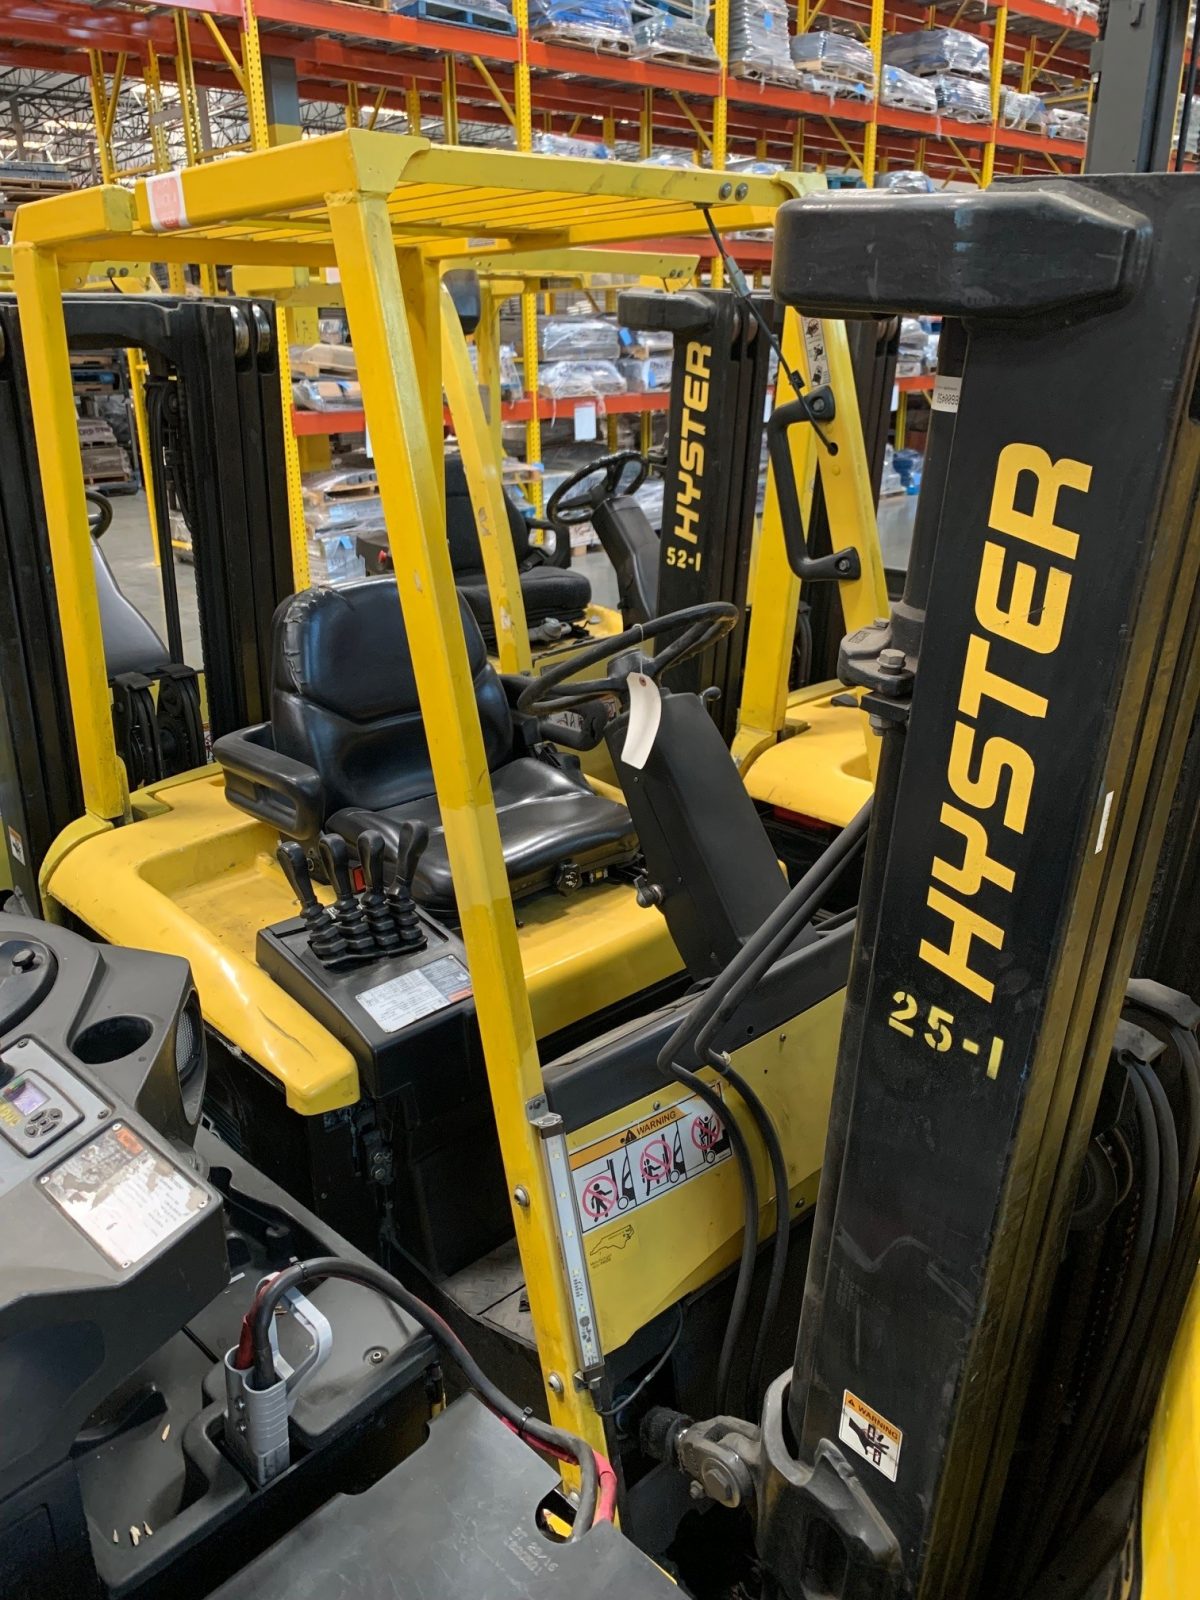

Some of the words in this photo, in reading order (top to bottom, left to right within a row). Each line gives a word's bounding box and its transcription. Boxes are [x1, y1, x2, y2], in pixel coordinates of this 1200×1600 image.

[674, 341, 712, 544] HYSTER
[666, 546, 702, 572] 52-1
[919, 442, 1093, 1004] HYSTER
[888, 991, 1004, 1079] 25-1
[636, 1110, 676, 1136] WARNING
[857, 1404, 899, 1440] WARNING
